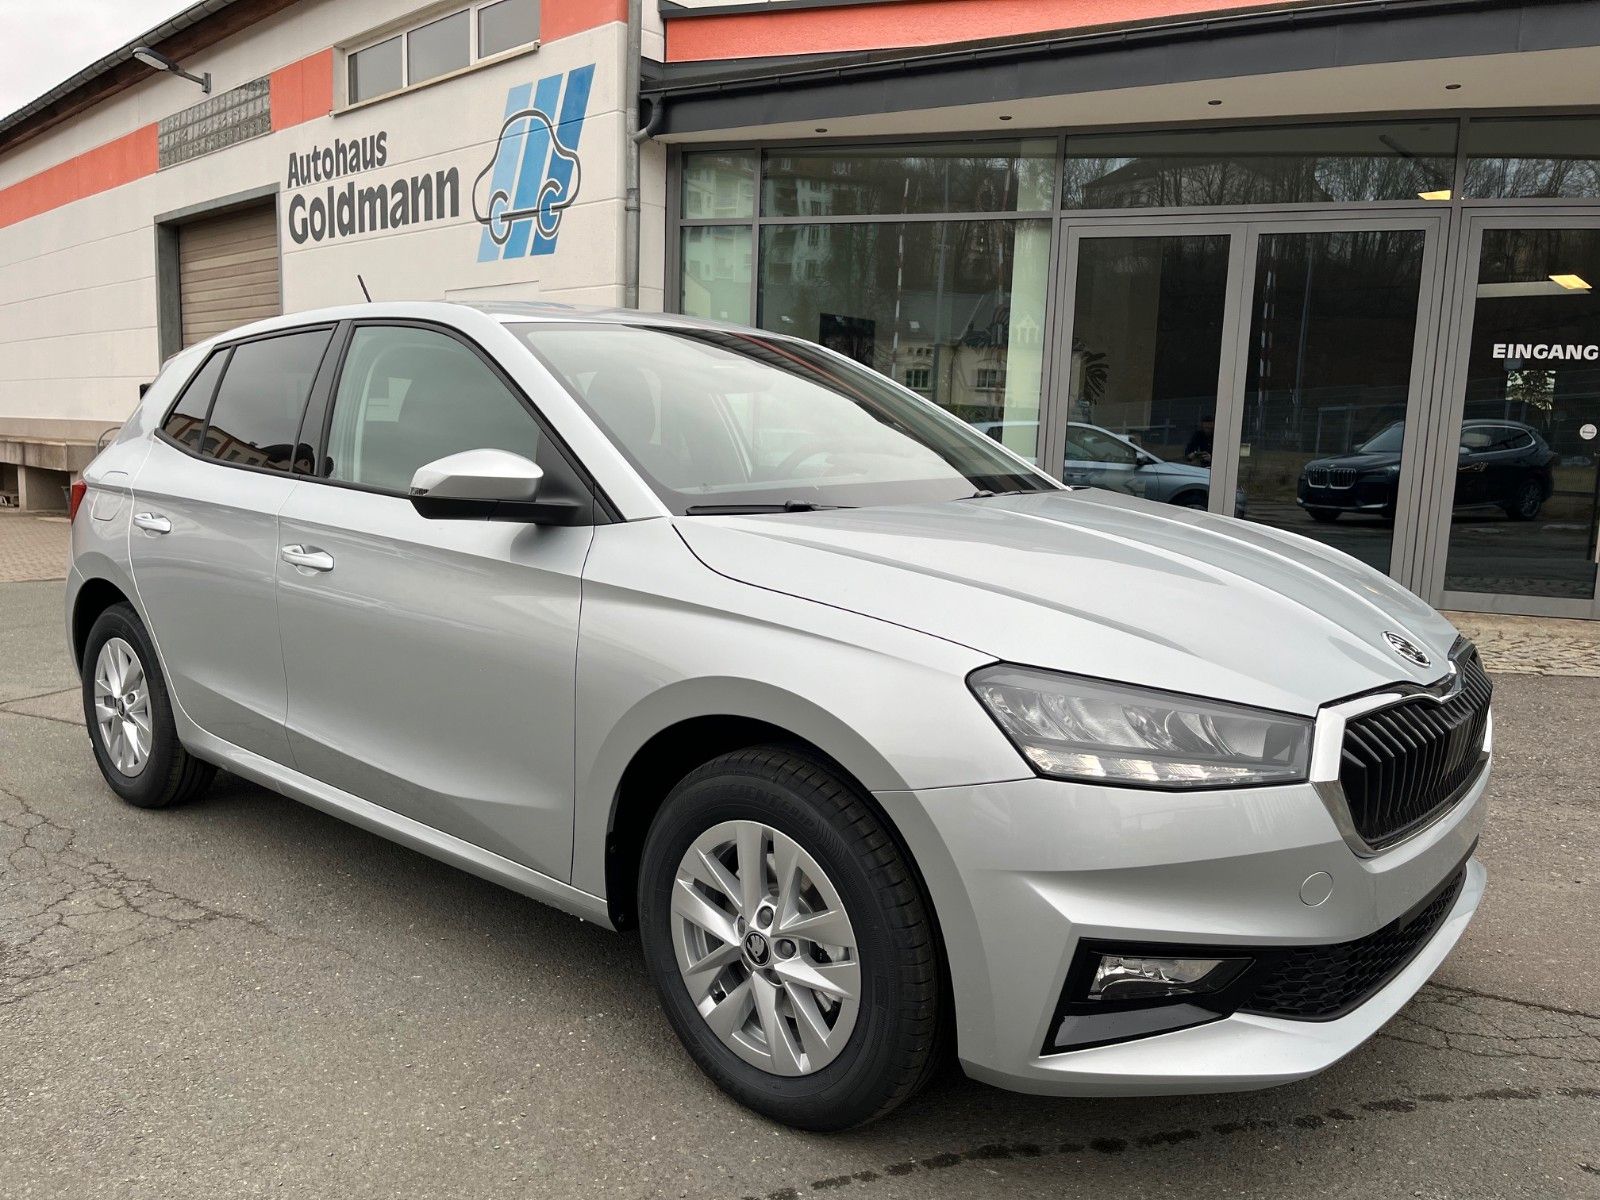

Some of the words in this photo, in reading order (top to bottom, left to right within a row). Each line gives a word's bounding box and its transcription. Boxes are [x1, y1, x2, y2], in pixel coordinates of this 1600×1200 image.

[287, 130, 388, 189] Autohaus
[288, 166, 460, 244] Goldmann
[1492, 343, 1599, 360] EINGANG
